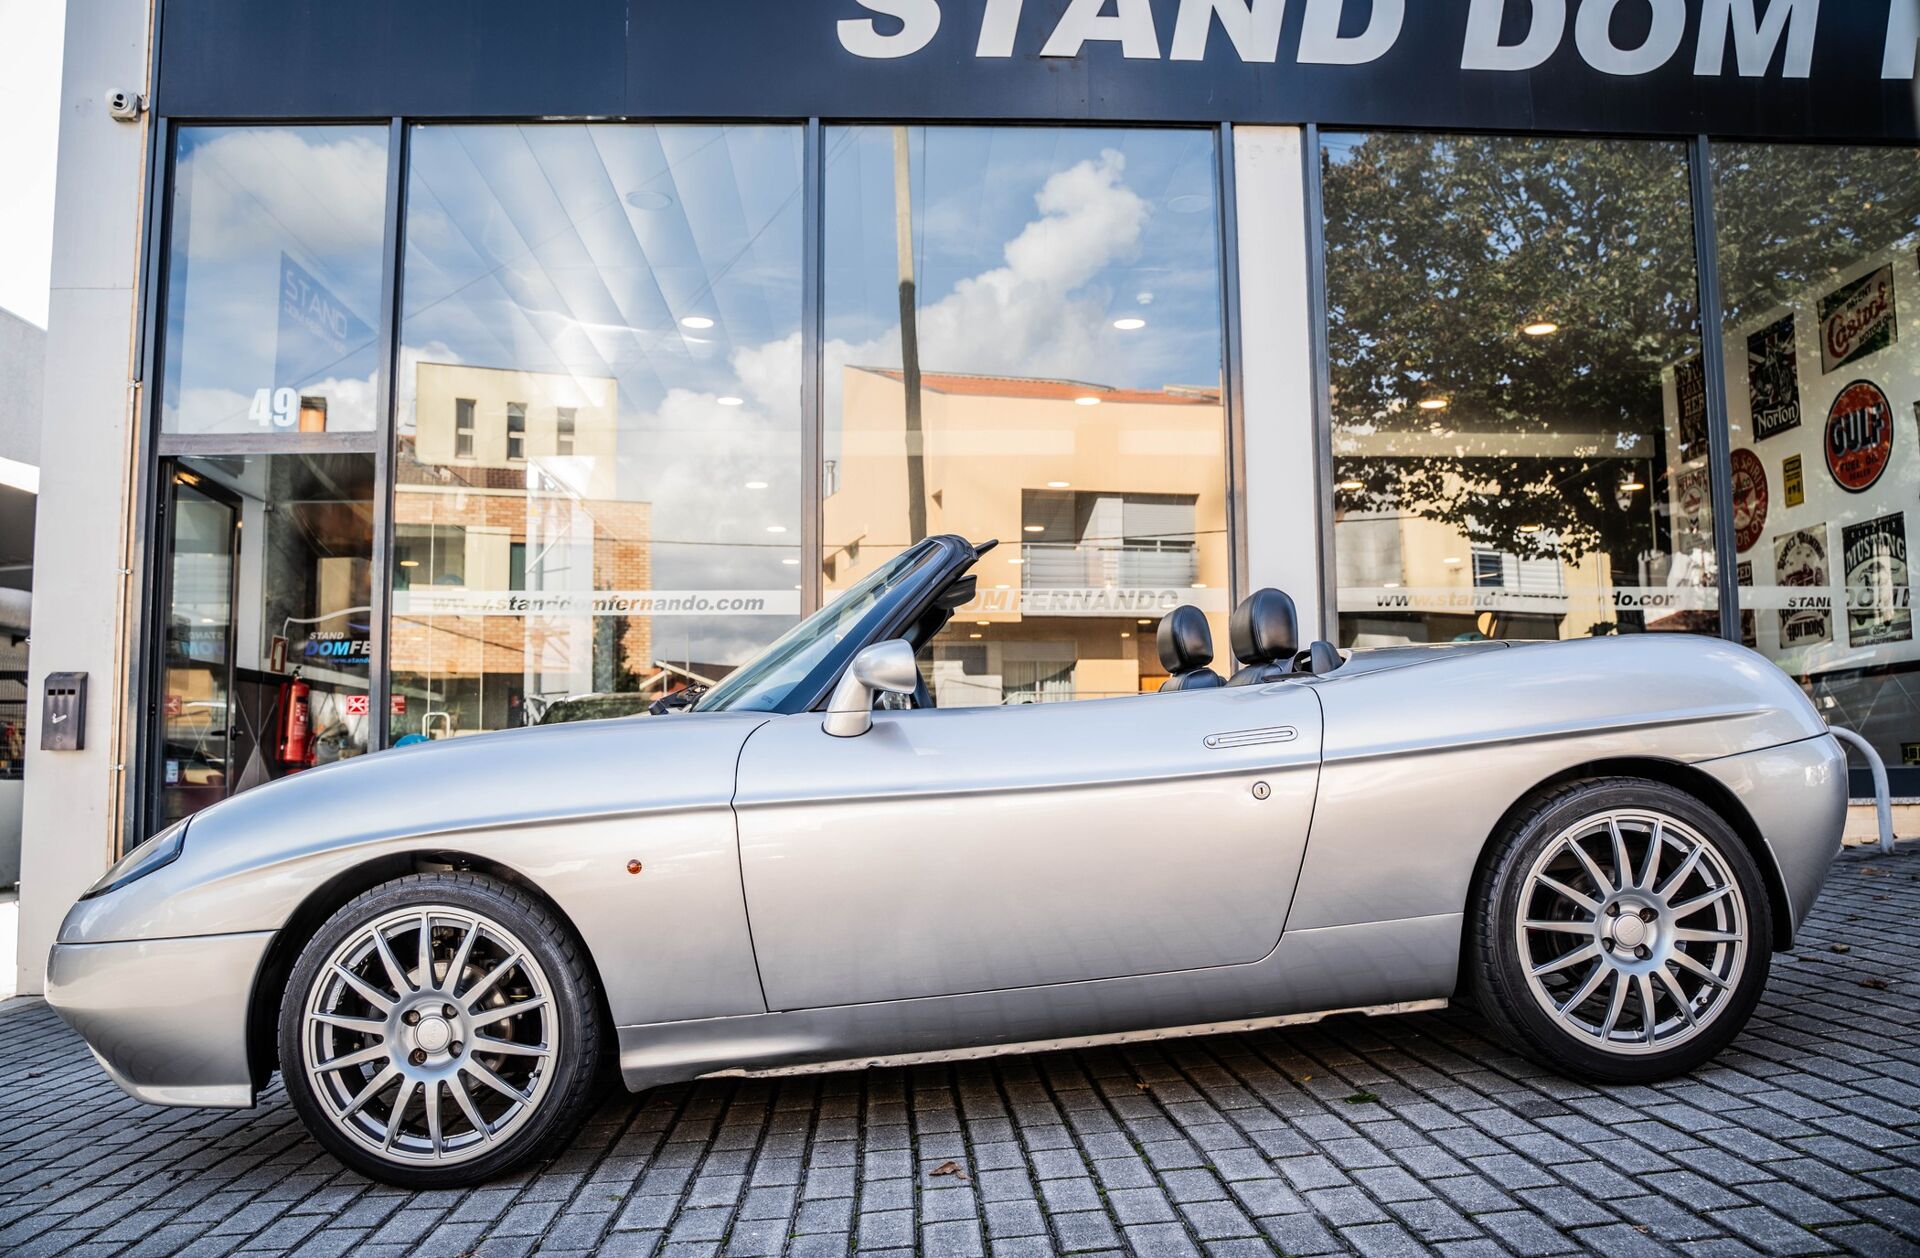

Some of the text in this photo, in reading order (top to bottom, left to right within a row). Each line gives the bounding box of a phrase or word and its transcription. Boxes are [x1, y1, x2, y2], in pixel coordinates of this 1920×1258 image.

[1460, 0, 1820, 78] DOM
[285, 269, 347, 340] STAND
[248, 387, 298, 427] 49
[1753, 400, 1799, 435] Norton
[1831, 403, 1884, 458] GULF
[1840, 459, 1861, 472] FUEL
[1845, 532, 1905, 575] MUSTANG
[309, 632, 344, 640] STAND
